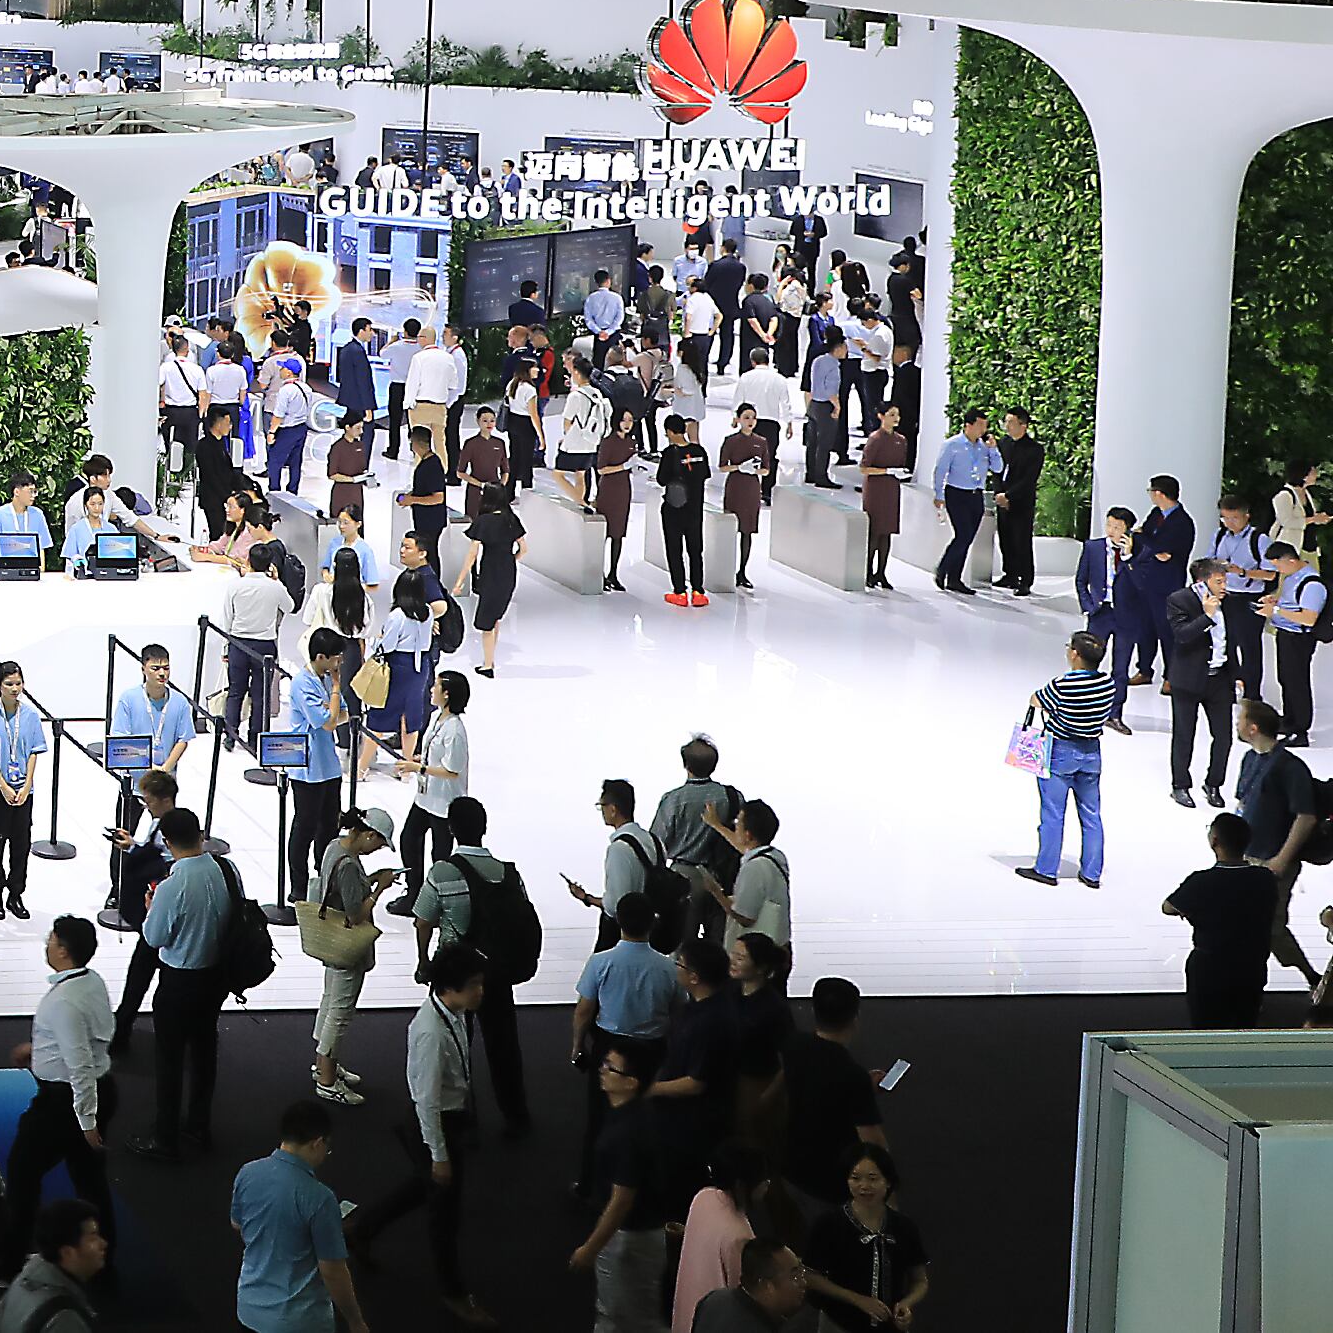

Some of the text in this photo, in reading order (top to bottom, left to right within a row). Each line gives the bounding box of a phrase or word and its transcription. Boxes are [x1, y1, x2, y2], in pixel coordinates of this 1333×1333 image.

[216, 65, 261, 83] from
[265, 65, 313, 83] Good
[317, 67, 338, 82] to
[340, 64, 394, 82] Great
[644, 137, 807, 171] HUAWEI
[319, 184, 891, 226] GUIDE to the Intelligent World
